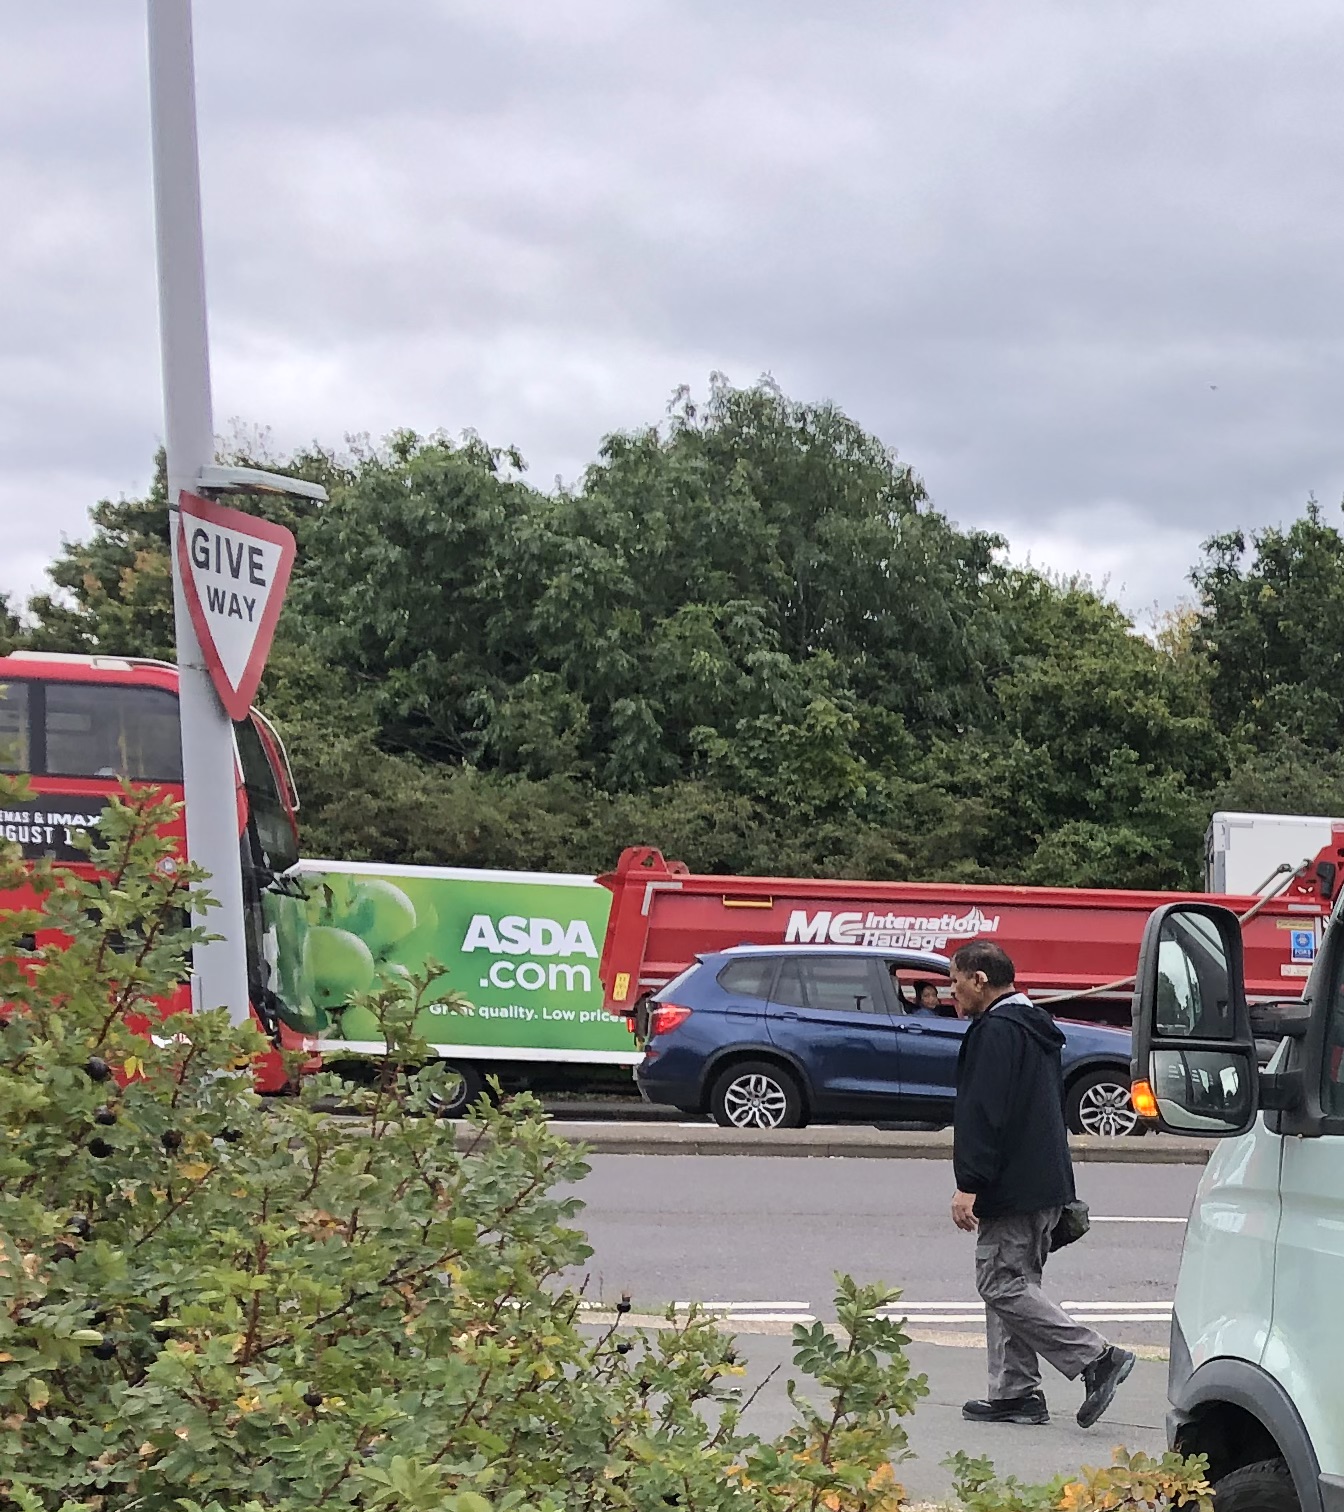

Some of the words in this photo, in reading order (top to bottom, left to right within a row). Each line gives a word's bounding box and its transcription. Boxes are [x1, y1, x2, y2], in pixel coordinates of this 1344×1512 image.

[191, 527, 266, 587] GIVE
[206, 584, 256, 622] WAY
[34, 811, 45, 824] &
[47, 812, 103, 827] IMAX
[865, 911, 1000, 933] International
[461, 914, 599, 958] ASDA
[862, 931, 948, 951] Haulage
[479, 959, 593, 992] .com
[478, 1005, 539, 1021] quality.
[542, 1007, 576, 1021] Low
